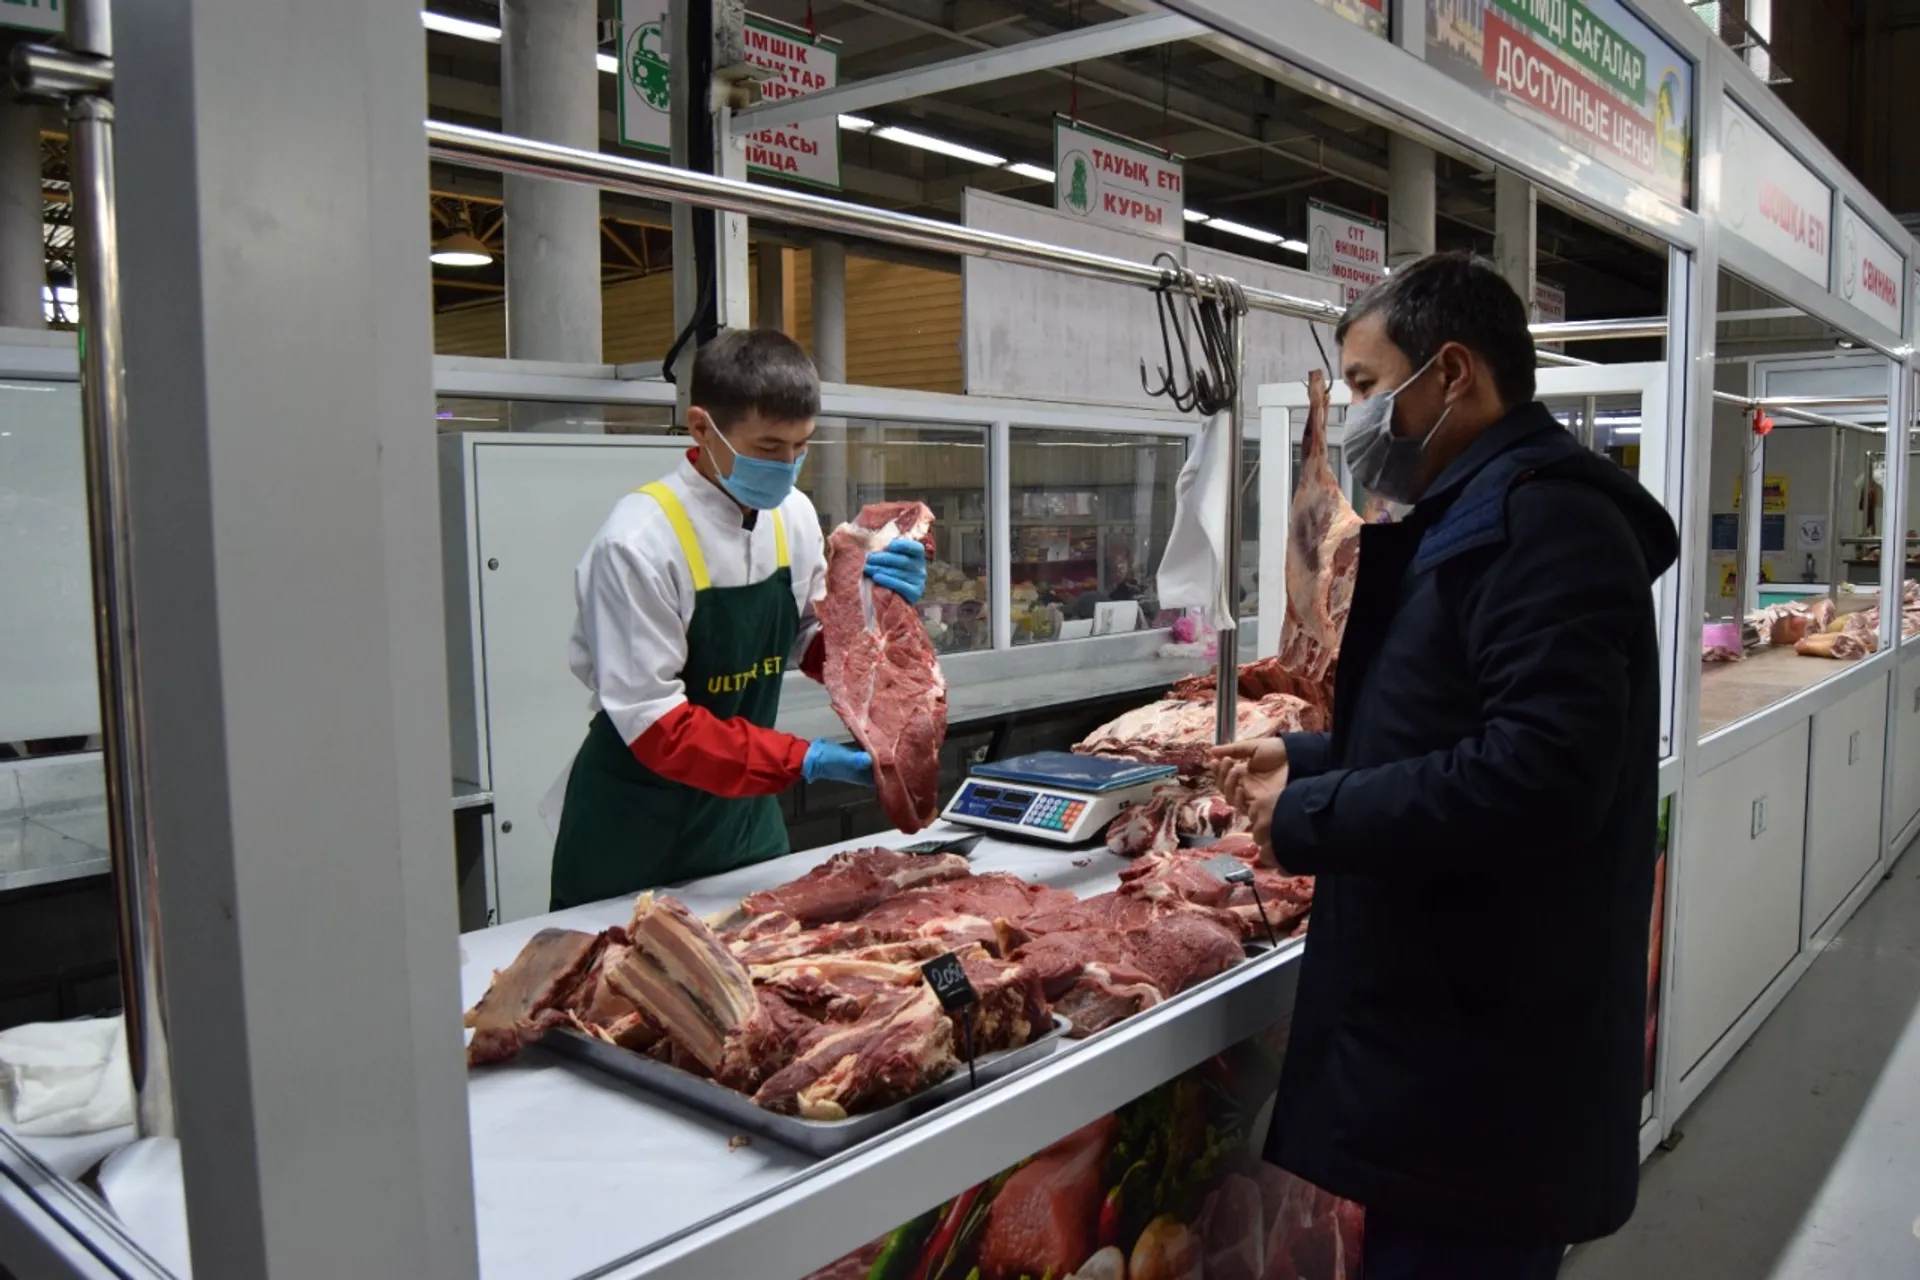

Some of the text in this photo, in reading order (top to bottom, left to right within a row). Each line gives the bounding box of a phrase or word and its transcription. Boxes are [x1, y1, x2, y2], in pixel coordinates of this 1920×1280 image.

[1571, 8, 1642, 91] БАҒАЛАР
[1496, 36, 1655, 169] ДОСТУПНЫЕ ЦЕНЫ
[1092, 148, 1180, 193] ТАУЫҚ ЕТІ
[1103, 192, 1162, 225] КУРЫ
[1863, 258, 1897, 310] СВИНИНА
[763, 656, 782, 676] ET
